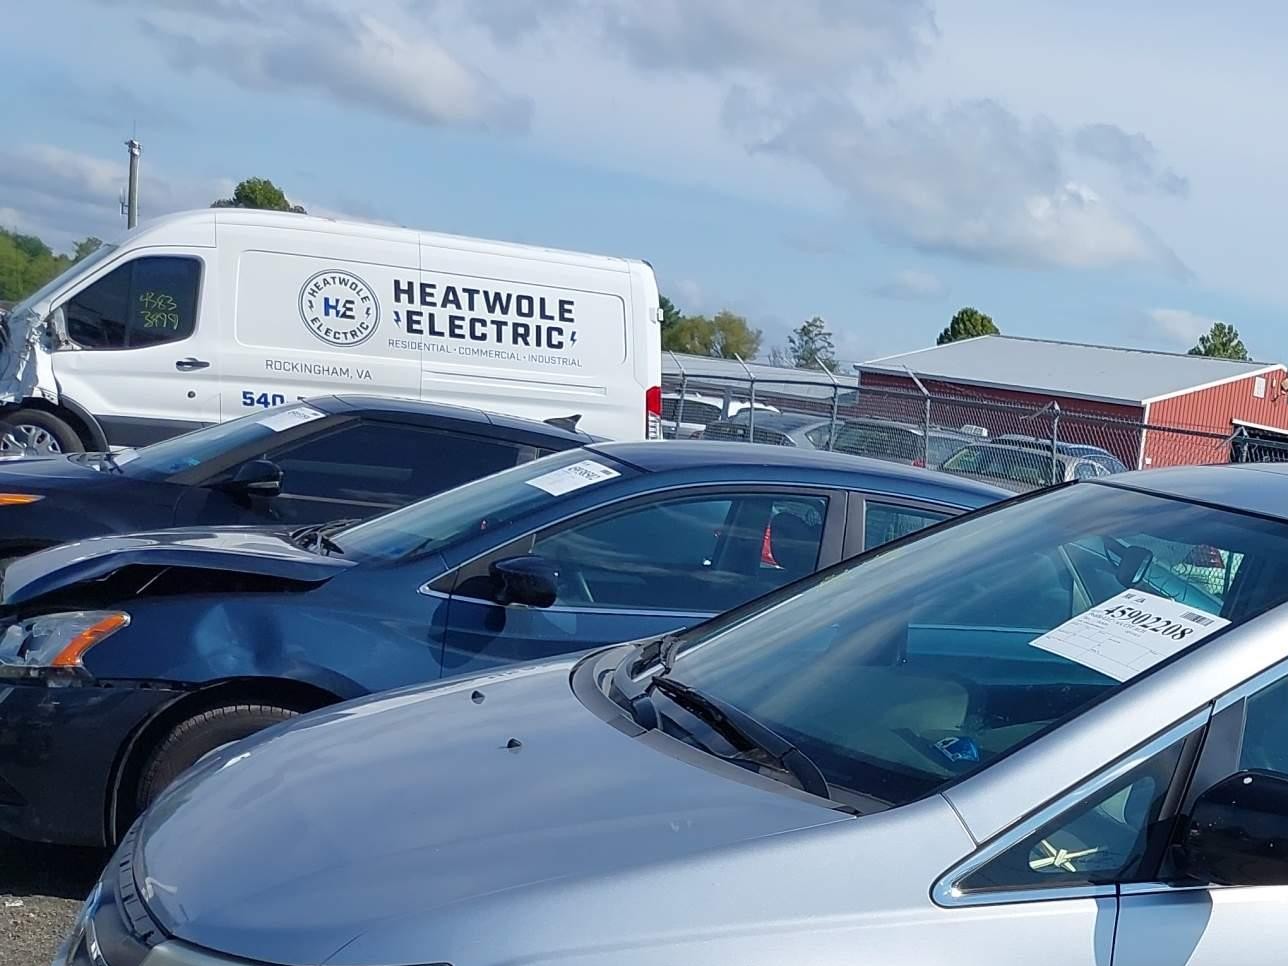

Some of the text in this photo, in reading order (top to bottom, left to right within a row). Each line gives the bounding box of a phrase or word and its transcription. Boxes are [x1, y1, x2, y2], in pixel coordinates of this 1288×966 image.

[307, 276, 371, 304] HEATWOLE
[393, 279, 575, 323] HEATWOLE
[323, 296, 356, 320] HE
[310, 316, 370, 341] ELECTRIC
[406, 309, 564, 350] ELECTRIC
[388, 338, 583, 368] RESIDENTIAL COMMERCIAL INDUSTRIAL
[265, 359, 373, 381] ROCKINGHAM, VA
[1103, 604, 1194, 641] 45902208
